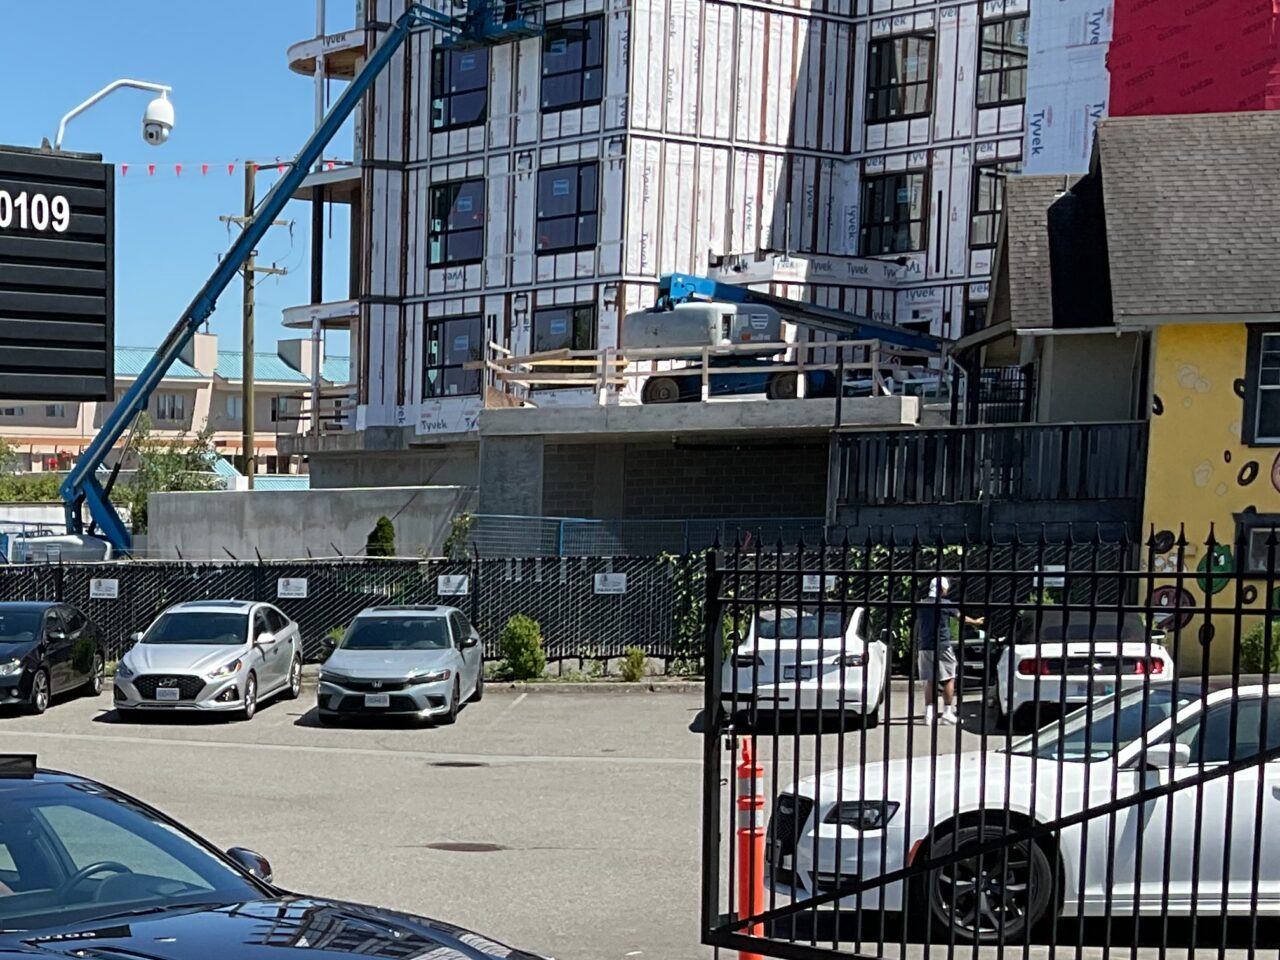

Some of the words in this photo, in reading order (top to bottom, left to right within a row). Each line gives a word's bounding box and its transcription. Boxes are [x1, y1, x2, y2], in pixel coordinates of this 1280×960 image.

[1087, 7, 1105, 46] Tyve
[1029, 109, 1045, 156] Tyvek
[909, 151, 938, 164] Tyvk
[746, 196, 754, 230] Tyvek
[847, 205, 858, 238] Tyvek
[810, 259, 833, 272] Tyvek
[847, 262, 869, 276] Tyvek
[904, 287, 936, 303] Tyvek
[421, 419, 448, 432] Tyvek
